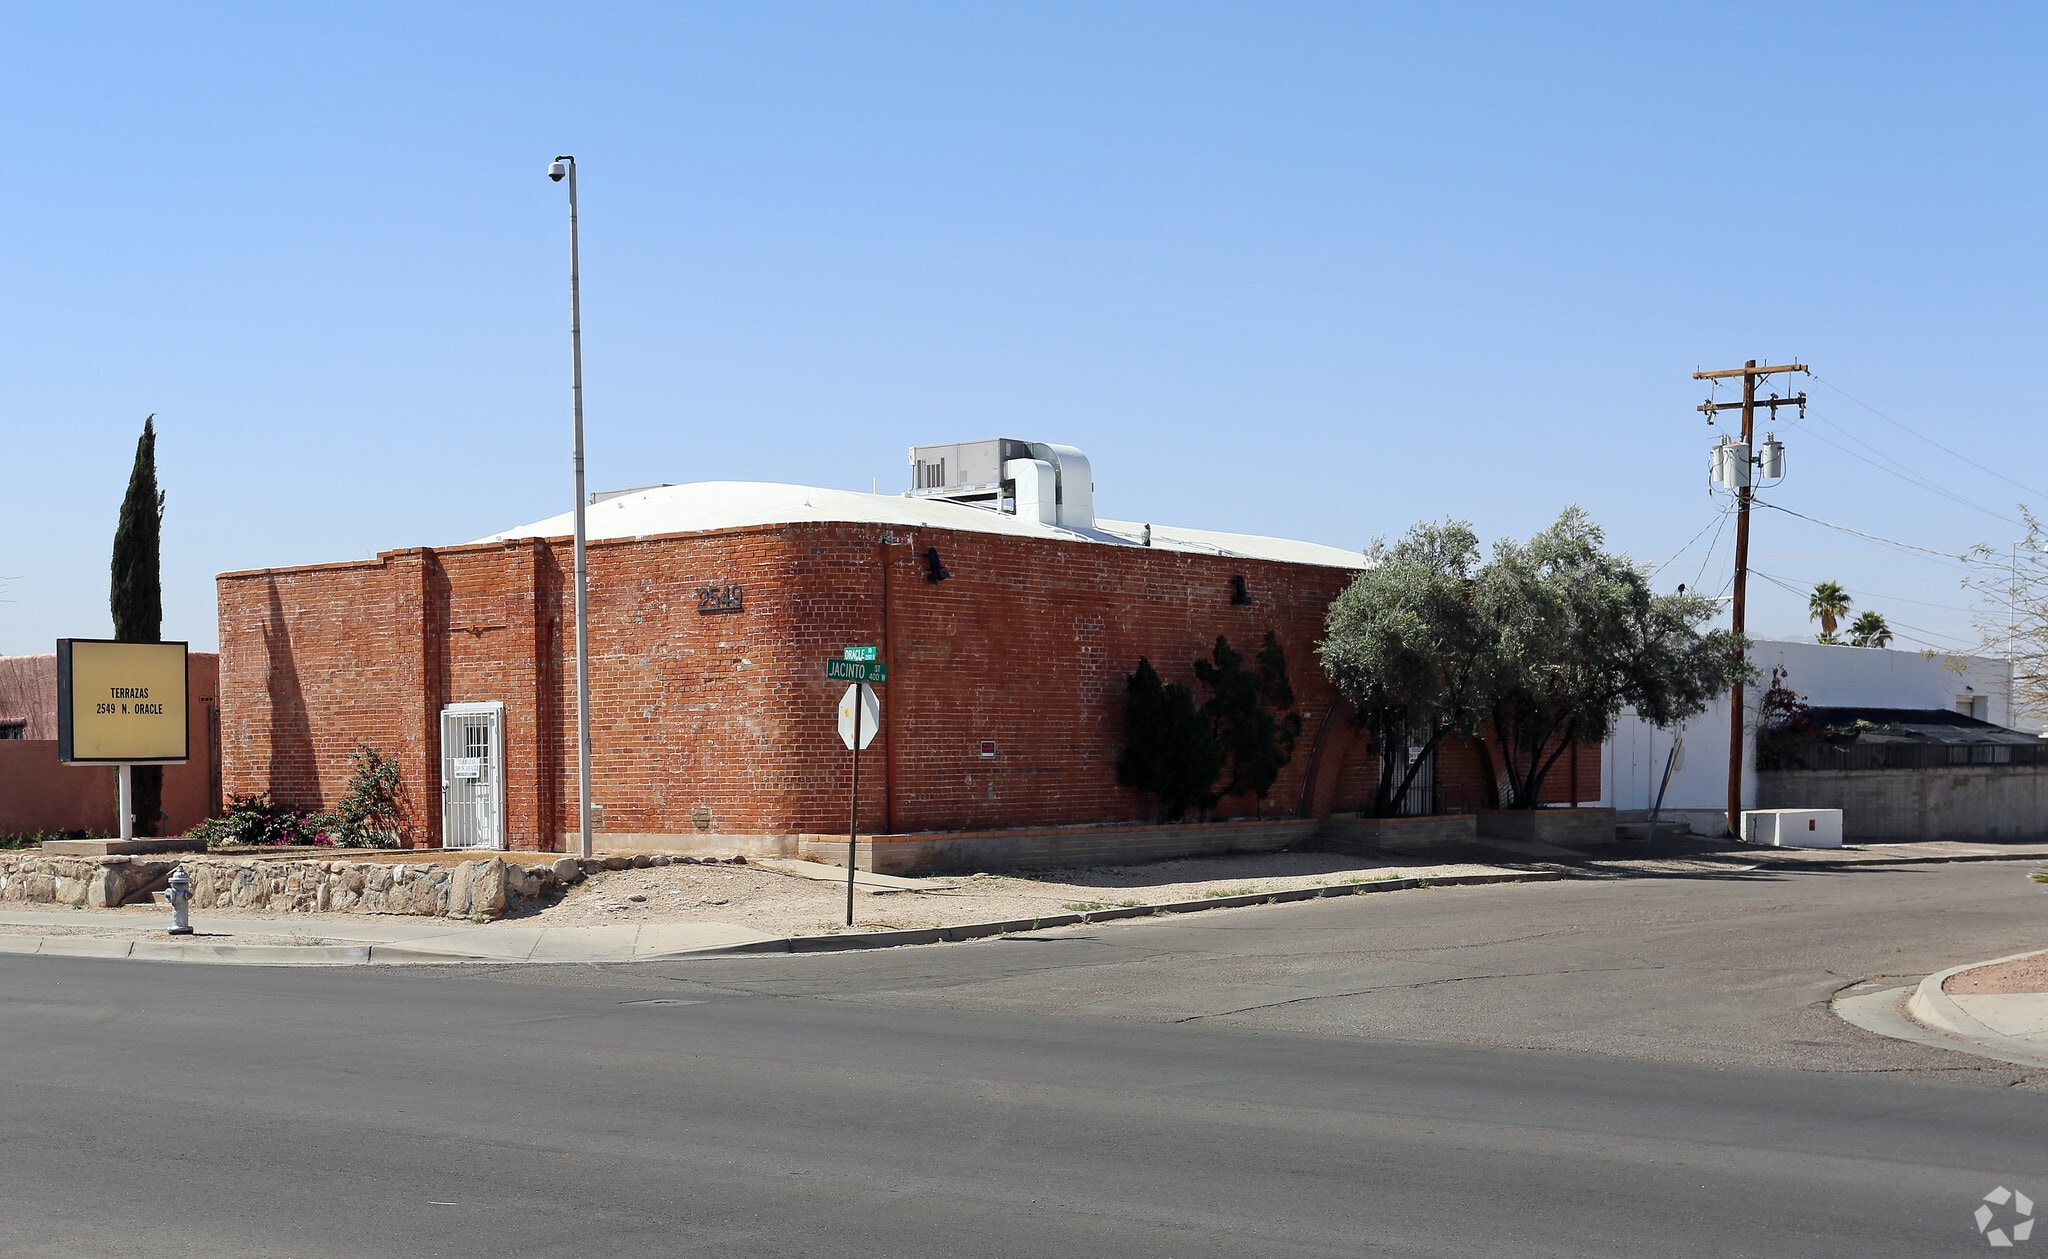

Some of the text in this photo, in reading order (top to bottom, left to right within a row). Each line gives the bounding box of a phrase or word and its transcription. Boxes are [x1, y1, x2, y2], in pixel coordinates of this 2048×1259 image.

[696, 584, 742, 610] 2549
[844, 649, 865, 660] ORACLE
[829, 662, 881, 679] JACINTO ST
[868, 672, 880, 681] 400
[110, 687, 149, 699] TERRAZAS
[96, 703, 163, 715] 2549 N. ORACLE
